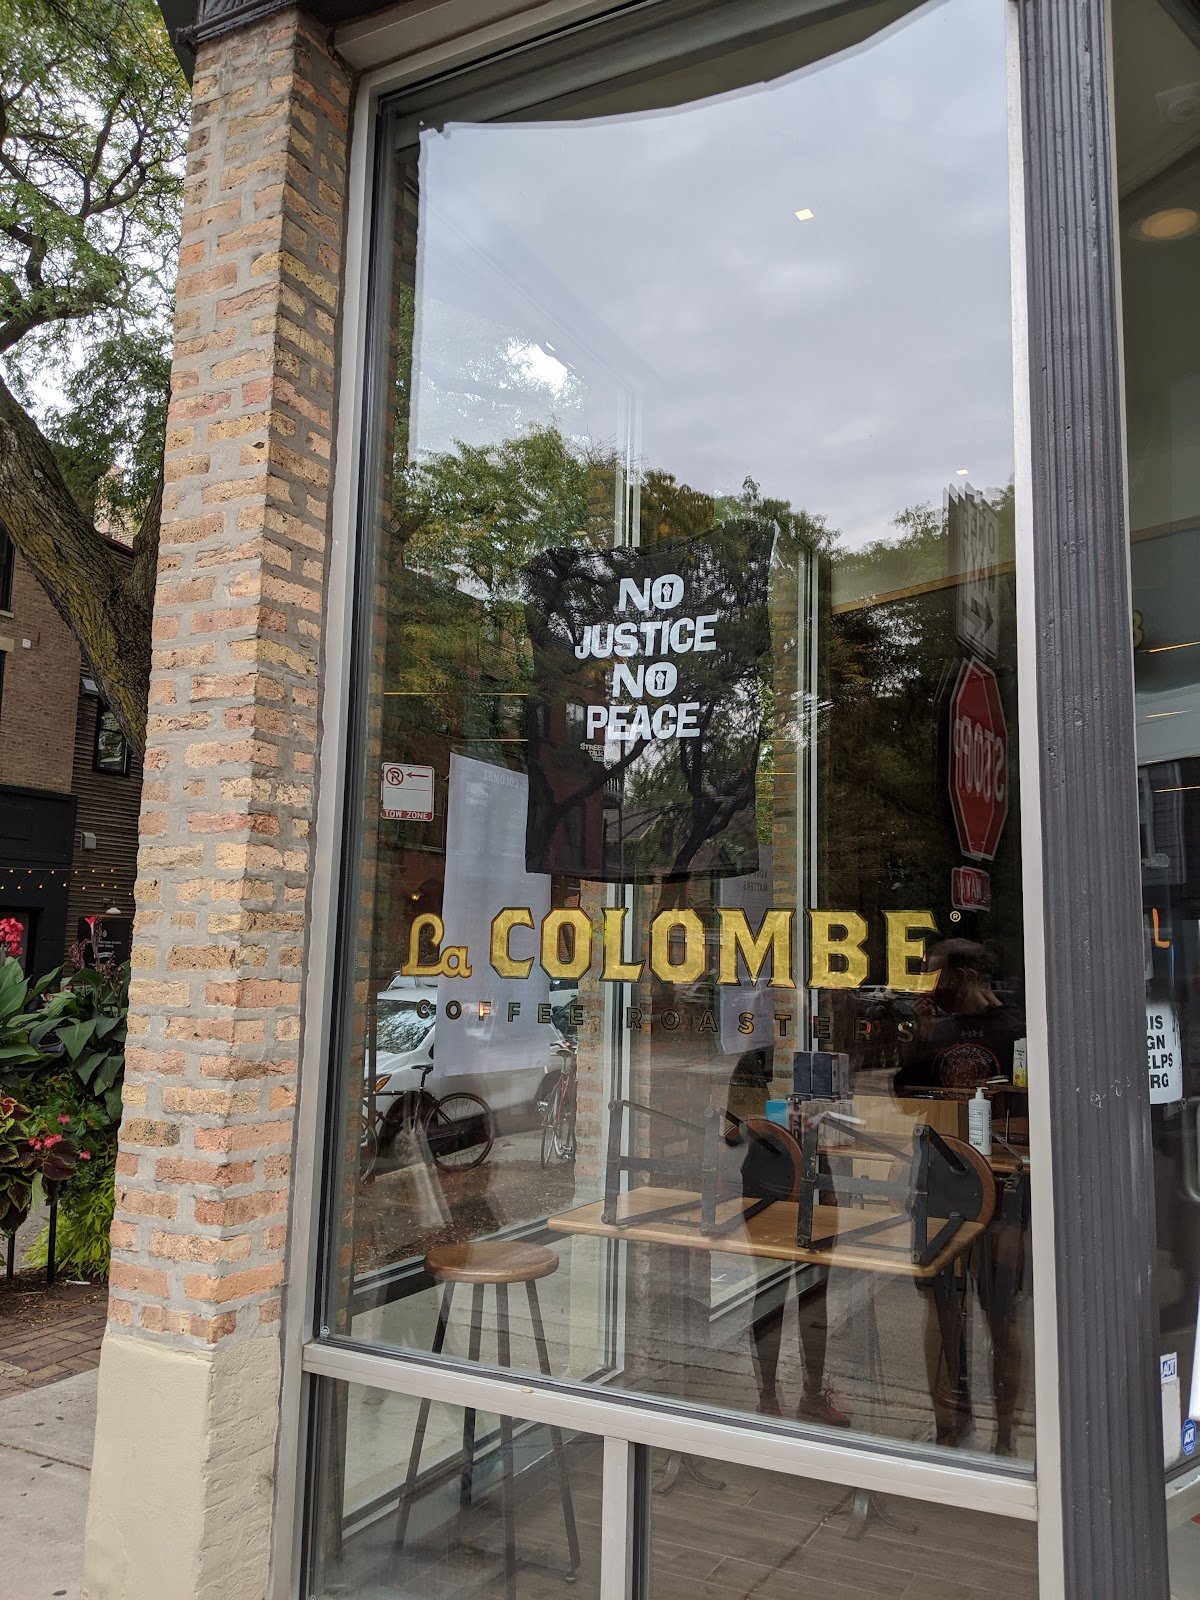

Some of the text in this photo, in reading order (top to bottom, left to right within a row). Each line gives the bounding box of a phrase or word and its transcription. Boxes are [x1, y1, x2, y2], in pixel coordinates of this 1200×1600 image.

[617, 573, 685, 612] NO
[574, 614, 719, 660] JUSTICE
[611, 661, 679, 698] NO
[586, 702, 701, 741] PEACE
[384, 809, 429, 820] TOW ZONE
[400, 913, 472, 978] La
[489, 906, 943, 993] COLOMBE
[416, 999, 916, 1044] COFFEE ROASTERS
